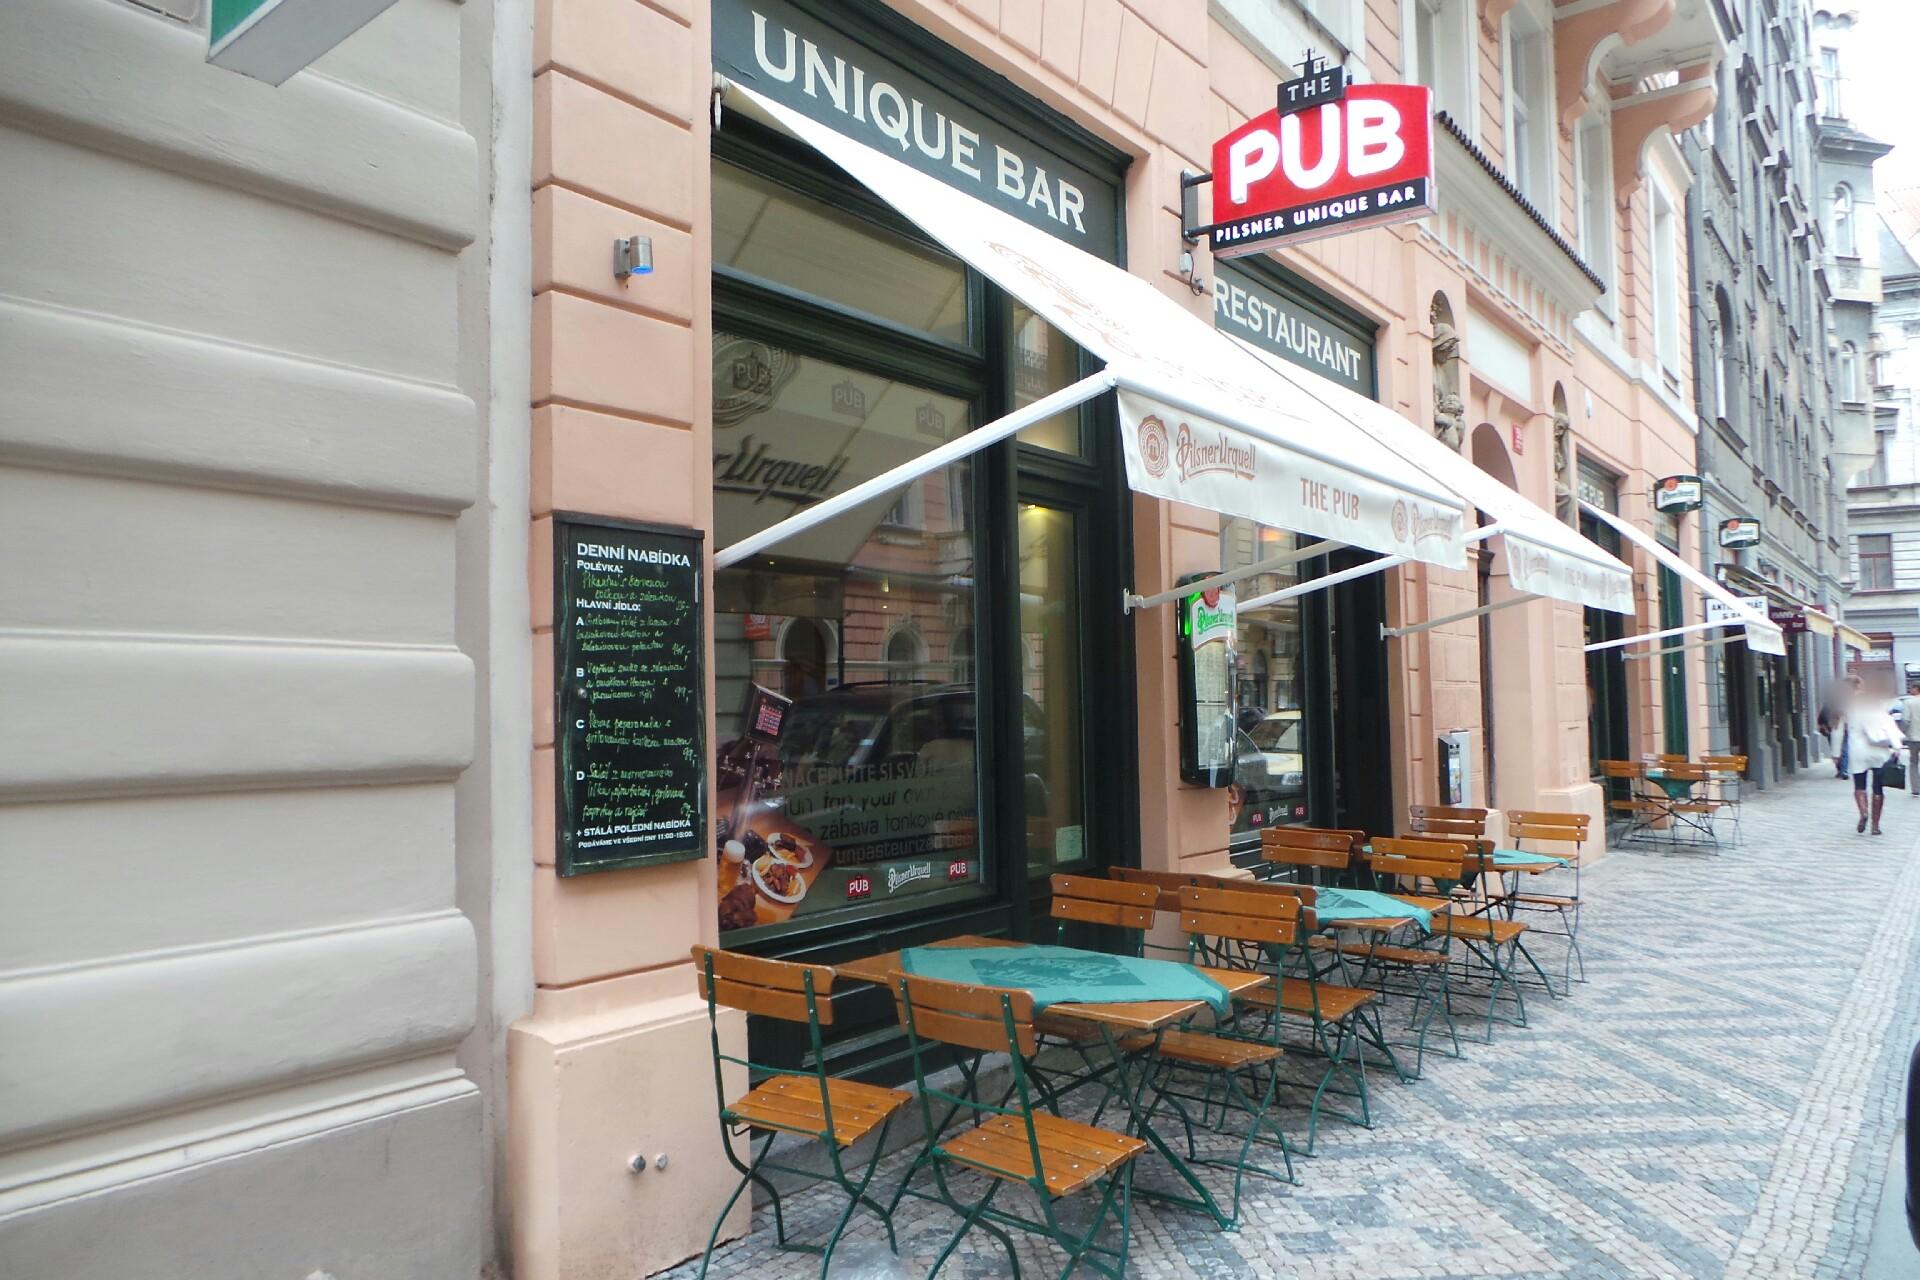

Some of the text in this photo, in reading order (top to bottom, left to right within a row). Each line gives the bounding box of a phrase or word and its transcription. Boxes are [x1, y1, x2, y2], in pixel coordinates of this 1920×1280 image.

[1287, 76, 1331, 103] THE
[751, 10, 1087, 234] UNIQUE BAR
[1229, 98, 1406, 205] PUB
[1215, 185, 1416, 243] PILSNER UNIQUE BAR
[1213, 275, 1361, 381] RESTAURANT
[834, 388, 863, 408] PUB
[918, 410, 943, 430] PUB
[1176, 422, 1221, 483] Pilsner
[1218, 432, 1256, 478] Urquell
[720, 434, 850, 504] Urquell
[1300, 477, 1360, 521] THE PUB
[577, 543, 691, 567] DENNÍ NABÍDKA
[576, 560, 623, 573] POLÉVKA:
[576, 598, 641, 611] HLAVNÍ JÍDLO:
[575, 617, 584, 626] A
[576, 667, 585, 678] B
[575, 719, 585, 729] C
[576, 771, 585, 781] D
[583, 825, 613, 837] STÁLÁ
[614, 821, 653, 833] POLEDNÍ
[653, 819, 691, 830] NABÍDKA
[820, 815, 880, 841] zábava
[888, 862, 931, 894] Pilsner Urquell
[949, 862, 967, 876] PUB
[849, 880, 869, 894] PUB
